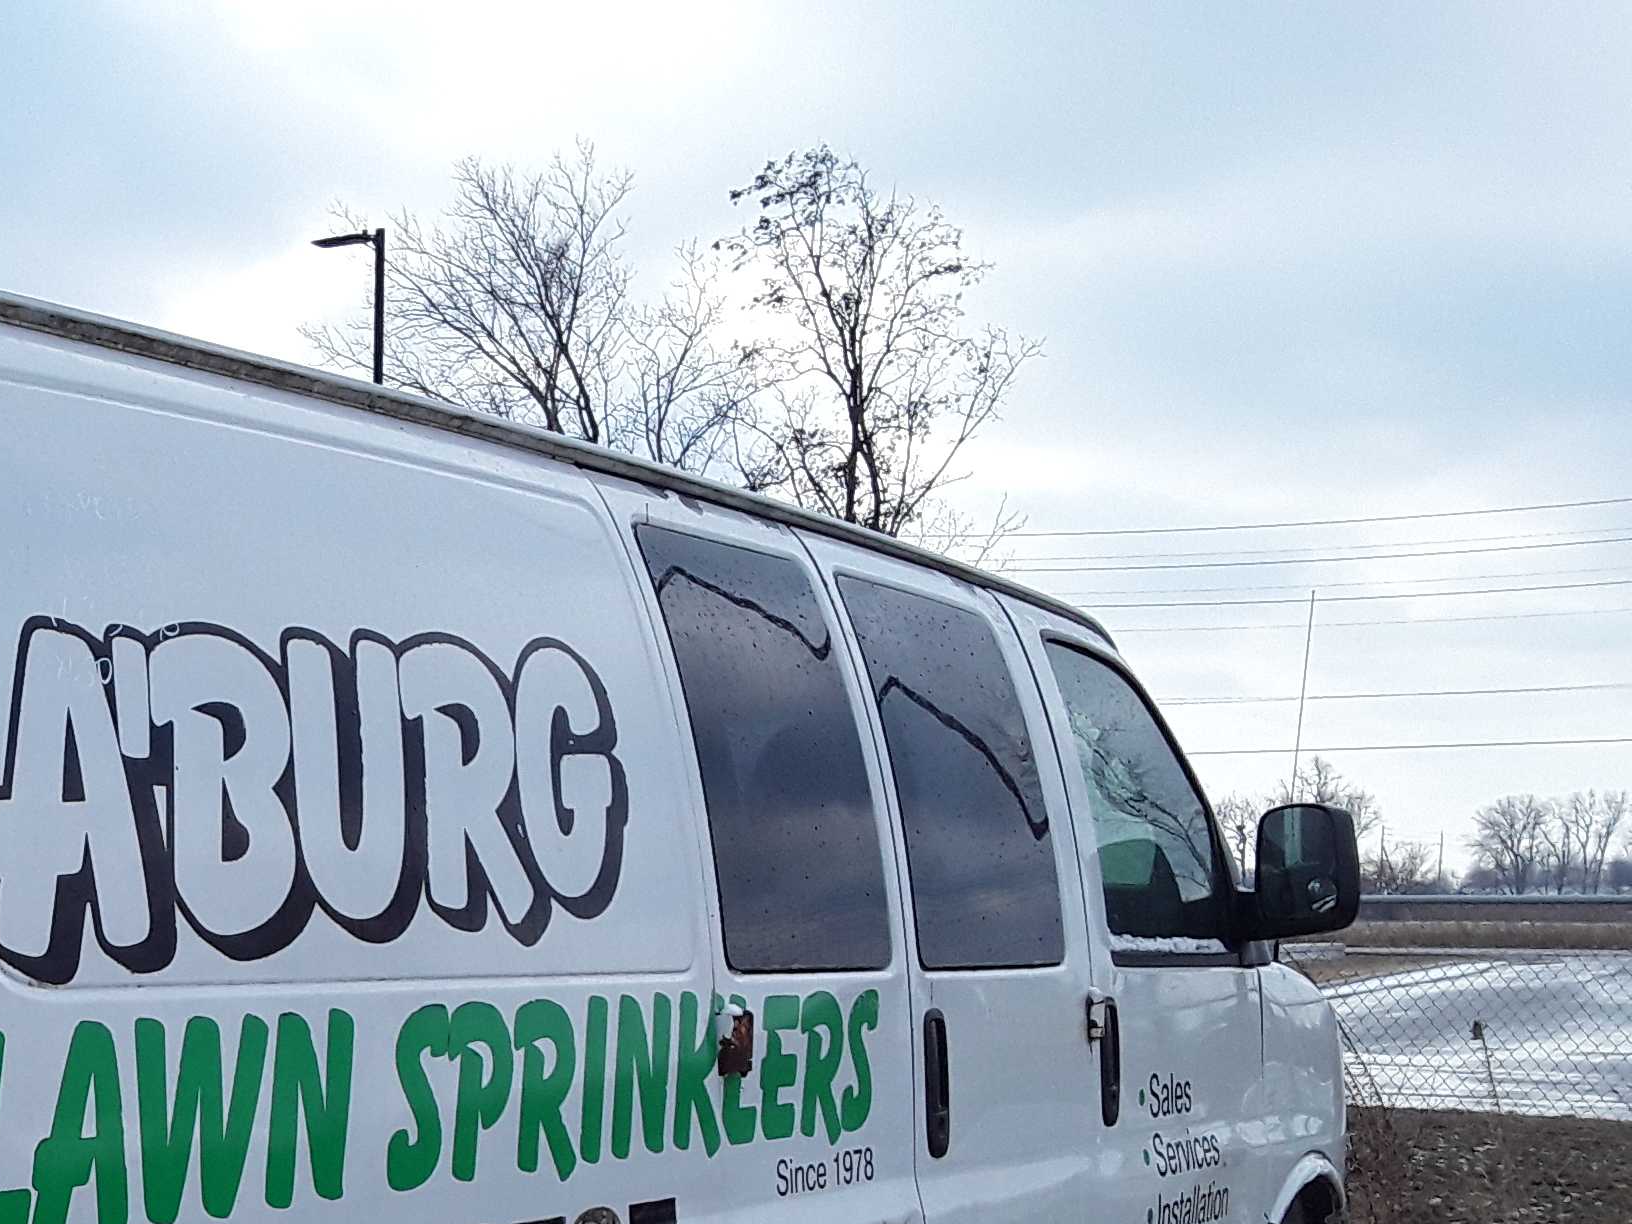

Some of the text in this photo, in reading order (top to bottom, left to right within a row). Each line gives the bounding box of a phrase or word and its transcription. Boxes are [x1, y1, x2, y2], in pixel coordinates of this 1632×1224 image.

[387, 989, 878, 1191] SPRINKLERS
[1148, 1073, 1192, 1118] Sales
[775, 1147, 875, 1198] Since 1978
[1152, 1132, 1221, 1178] Services
